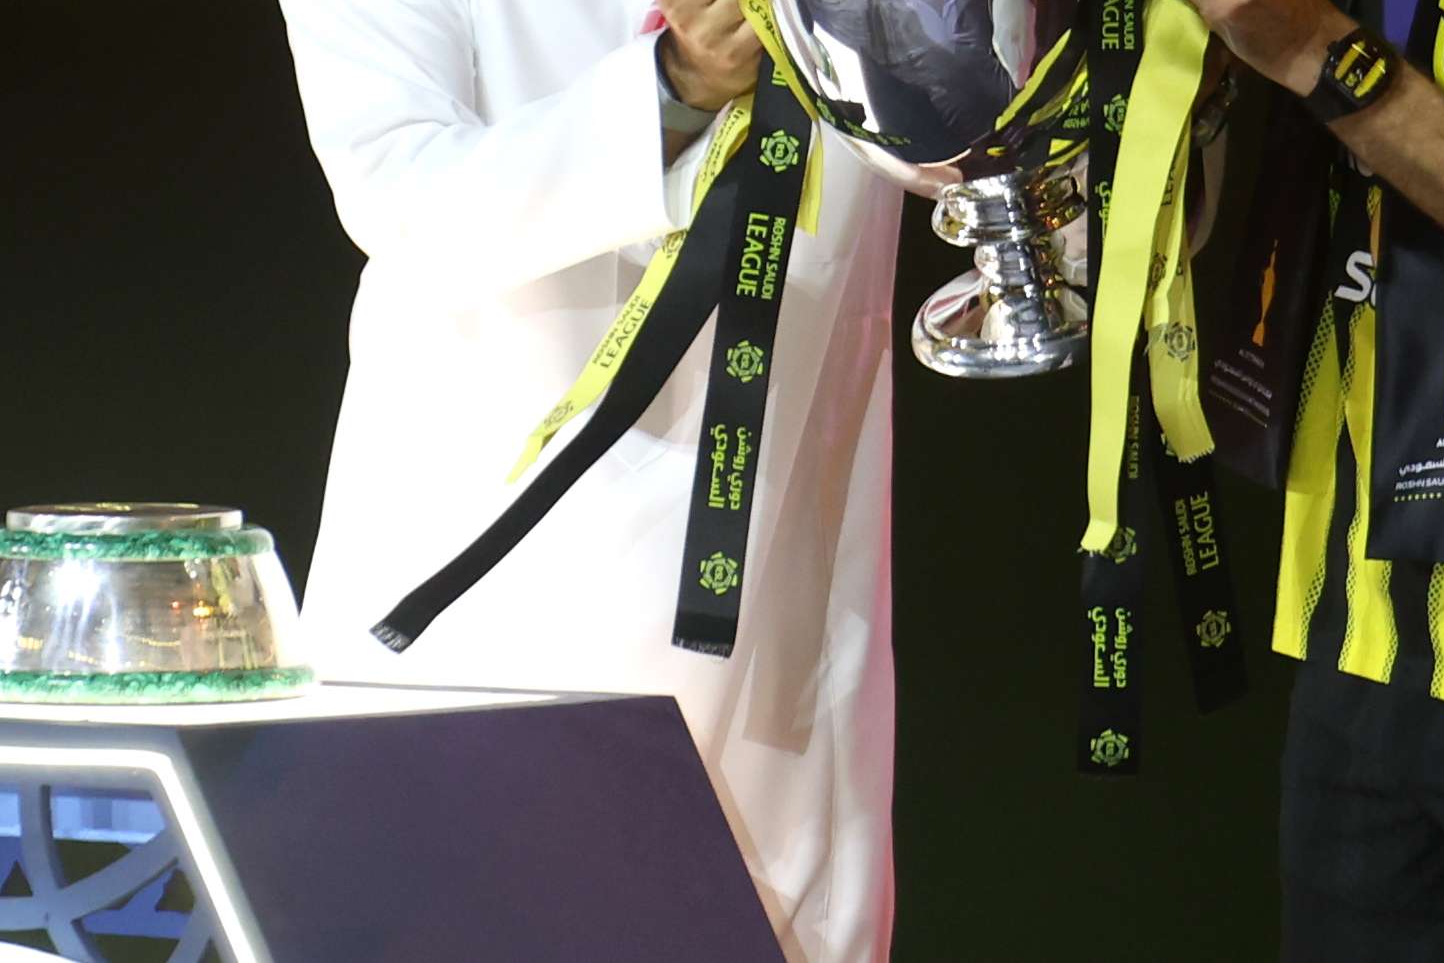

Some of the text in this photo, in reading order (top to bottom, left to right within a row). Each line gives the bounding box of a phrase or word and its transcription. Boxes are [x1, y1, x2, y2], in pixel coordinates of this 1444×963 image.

[1122, 11, 1136, 51] SAUDI
[735, 211, 770, 298] LEAGUE
[760, 216, 787, 301] ROSHN SAUDI
[600, 299, 652, 369] LEAGUE
[708, 423, 728, 509] السعودي
[1189, 490, 1220, 570] LEAGUE
